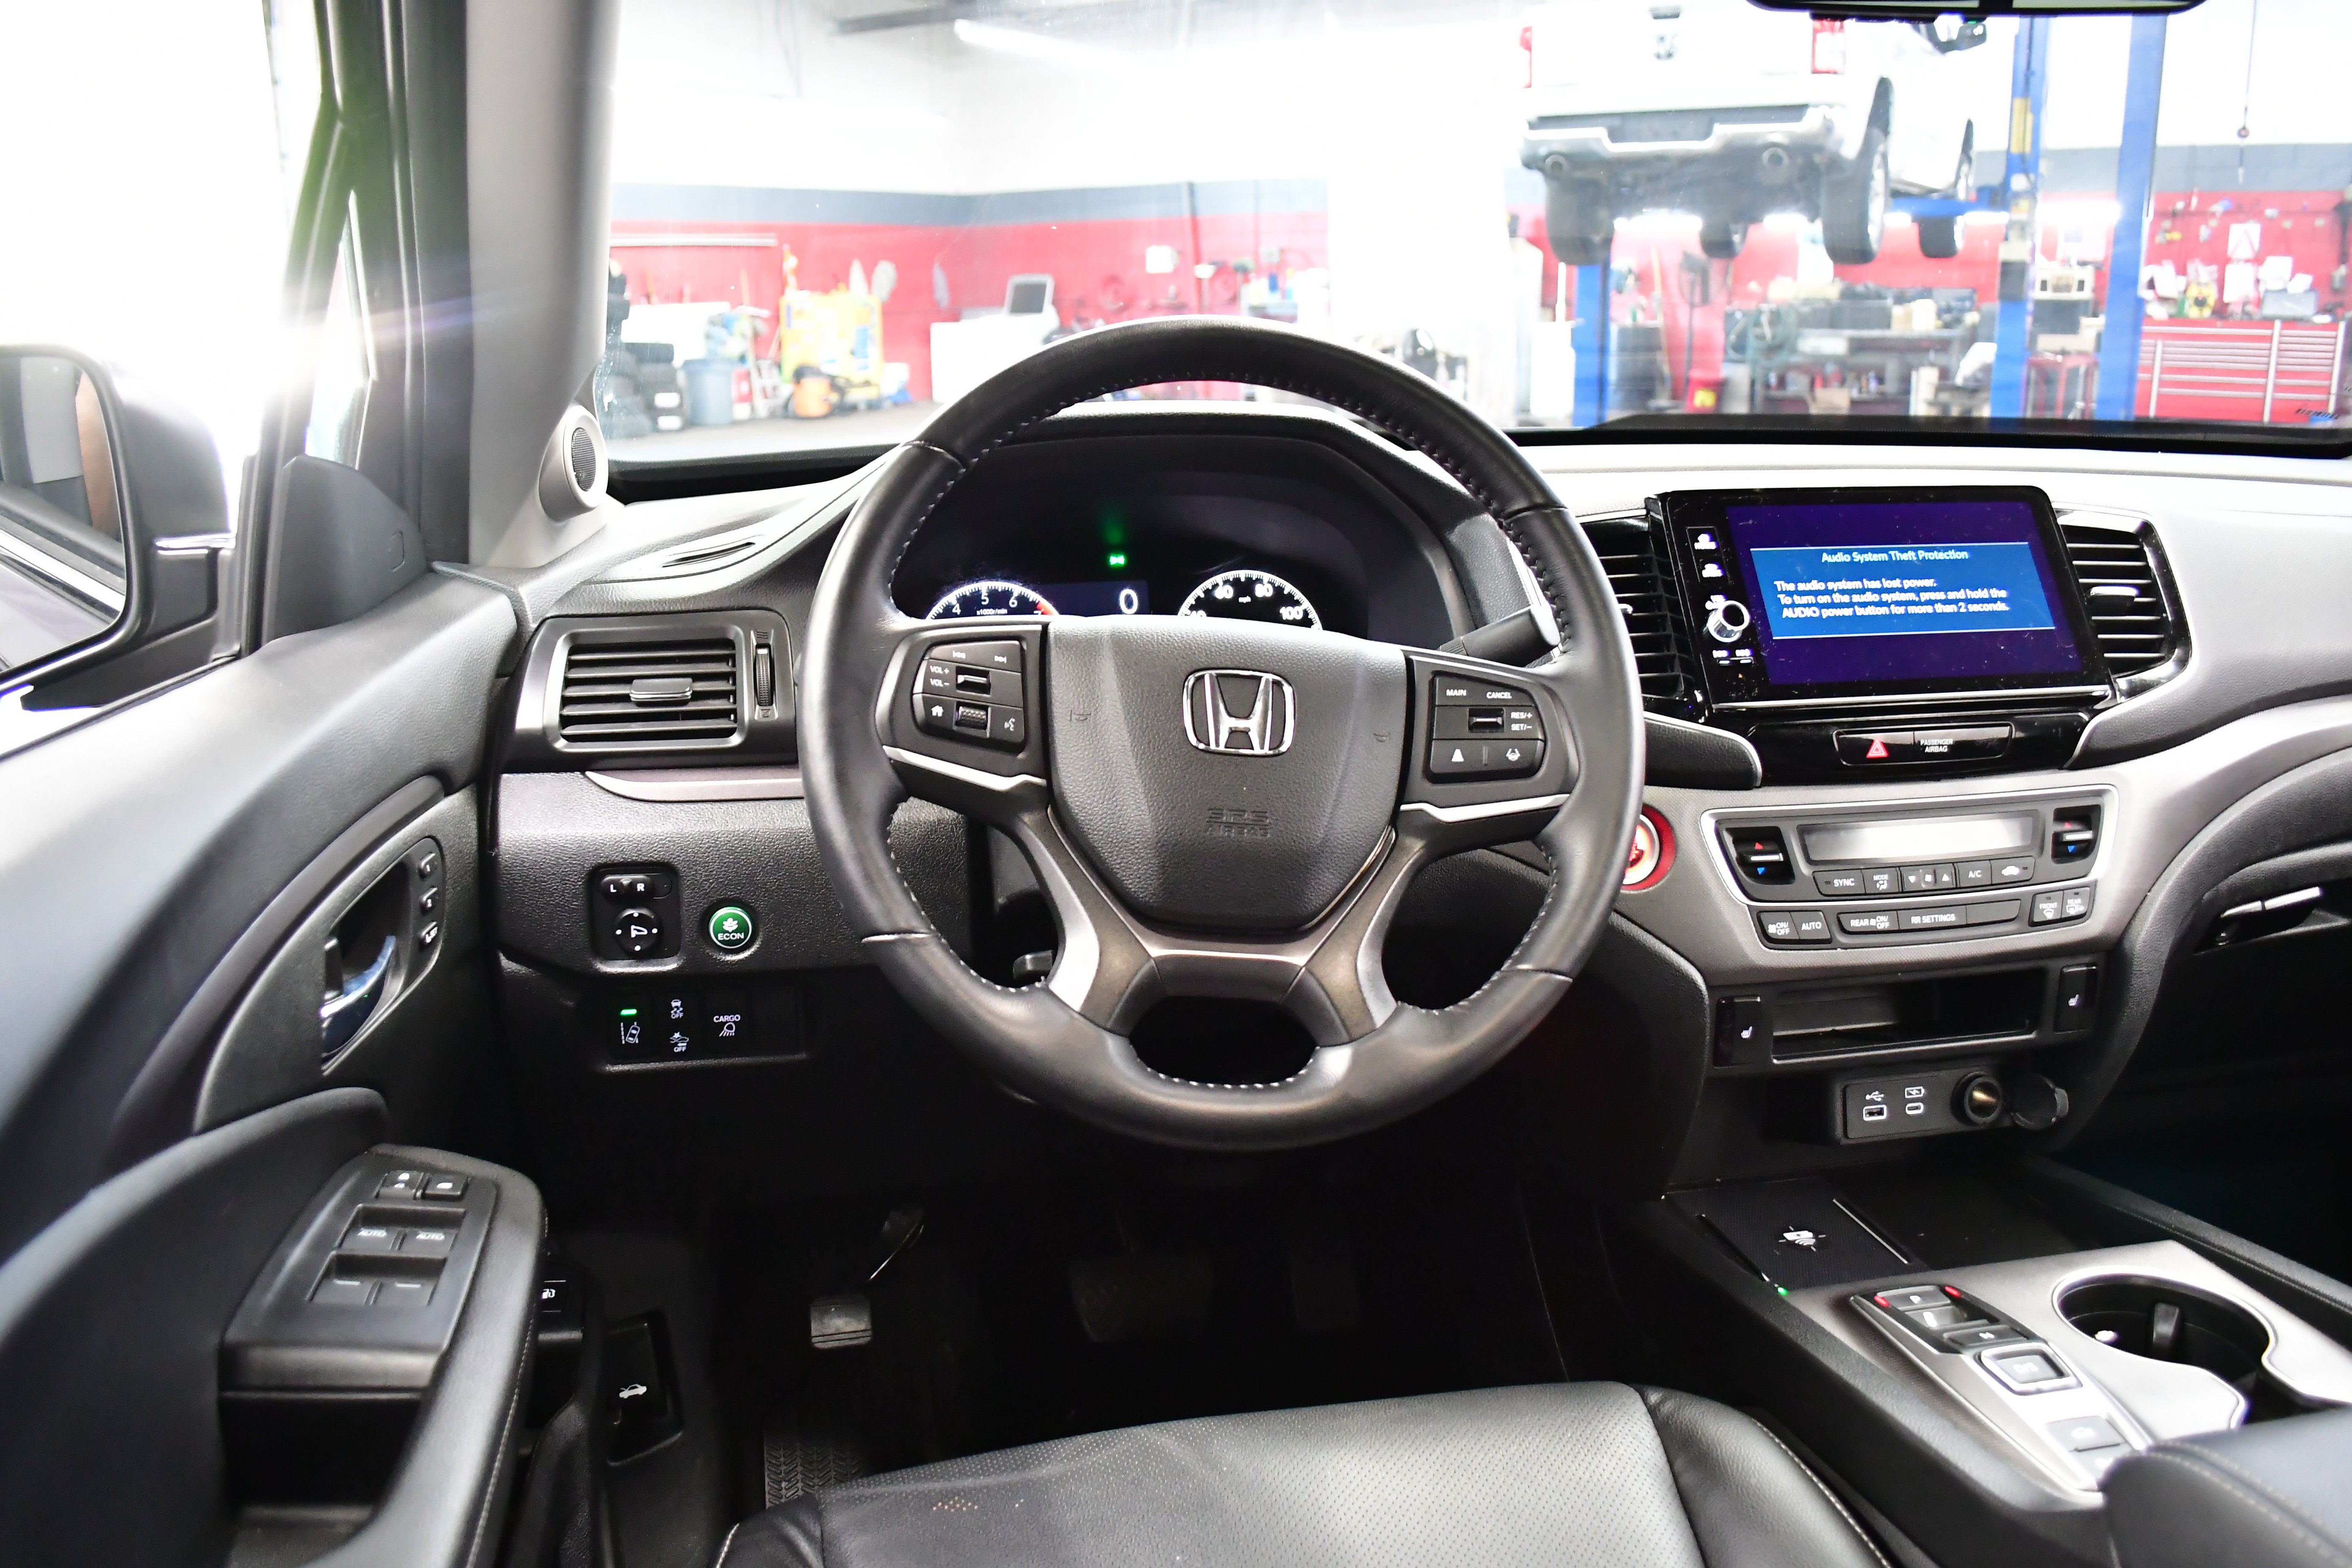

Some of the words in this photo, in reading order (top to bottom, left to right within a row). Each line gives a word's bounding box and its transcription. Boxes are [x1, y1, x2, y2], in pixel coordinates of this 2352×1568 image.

[1822, 552, 1851, 563] Audio
[1852, 552, 1888, 564] System
[1889, 550, 1916, 561] Theft
[1918, 550, 1968, 560] Protection
[1255, 583, 1273, 597] 80
[1774, 580, 1795, 591] The
[1797, 580, 1825, 591] audio
[1827, 580, 1862, 591] system
[1863, 578, 1881, 588] has
[1882, 578, 1902, 588] lost
[1903, 579, 1937, 589] power.
[1214, 585, 1234, 599] 60
[1777, 594, 1792, 604] To
[1793, 594, 1816, 604] turn
[1817, 595, 1831, 603] on
[1832, 593, 1850, 603] the
[1851, 591, 1879, 602] audio
[1881, 591, 1918, 603] system,
[1919, 591, 1946, 602] press
[1947, 589, 1965, 599] and
[1965, 588, 1989, 599] hold
[1990, 588, 2006, 598] the
[981, 592, 989, 605] 5
[1009, 596, 1018, 608] 6
[1119, 588, 1138, 615] 0
[952, 603, 961, 615] 4
[1279, 606, 1303, 620] 100
[1782, 607, 1819, 618] AUDIO
[1821, 607, 1853, 618] power
[1854, 605, 1889, 616] button
[1890, 604, 1906, 614] for
[1907, 605, 1933, 614] more
[1934, 602, 1957, 613] than
[1958, 602, 1966, 612] 2
[1967, 601, 2009, 612] seconds.
[1968, 870, 1982, 878] A/C
[610, 884, 617, 892] L
[1834, 878, 1855, 887] SYNC
[1851, 918, 1869, 927] REAR
[1911, 916, 1921, 924] RR
[1922, 913, 1956, 923] SETTINGS
[1802, 921, 1822, 931] AUTO
[718, 932, 744, 940] ECON
[713, 1014, 741, 1023] CARGO
[357, 1229, 387, 1237] AUTO
[416, 1232, 445, 1240] AUTO
[1910, 1295, 1920, 1304] P
[1979, 1331, 1994, 1339] N
